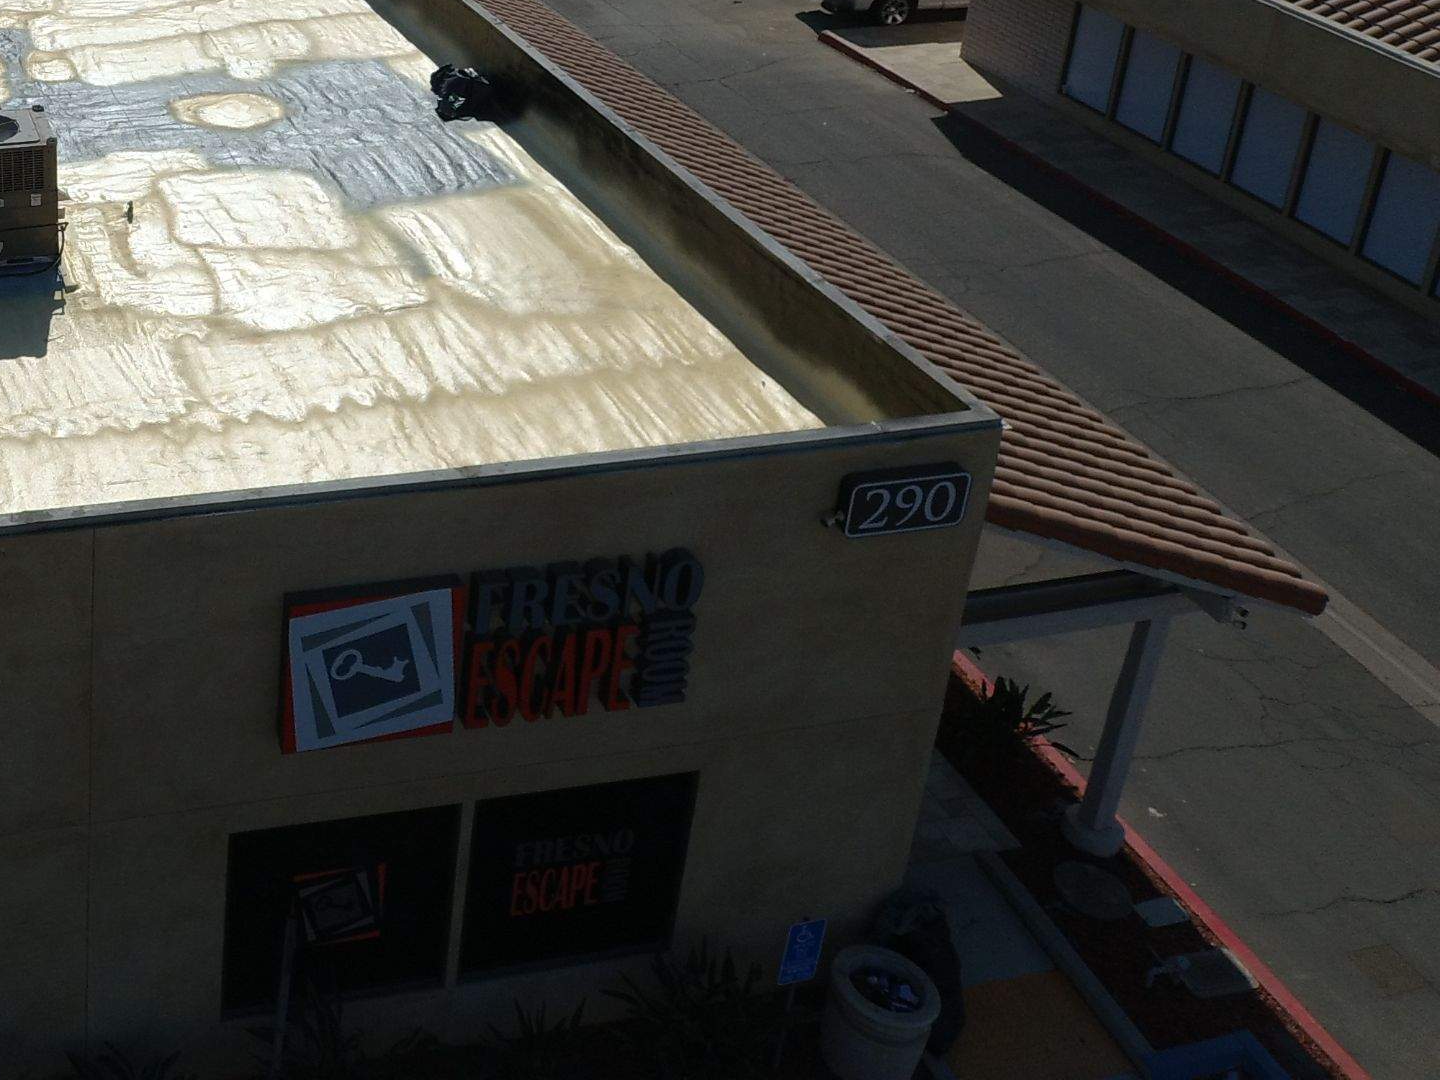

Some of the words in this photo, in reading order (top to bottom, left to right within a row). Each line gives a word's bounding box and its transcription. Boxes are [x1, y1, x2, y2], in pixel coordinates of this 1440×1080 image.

[859, 480, 957, 529] 290
[471, 556, 704, 634] FRESNO
[463, 624, 641, 730] ESCAPE
[514, 829, 636, 867] FRESNO
[510, 860, 604, 916] ESCAPE
